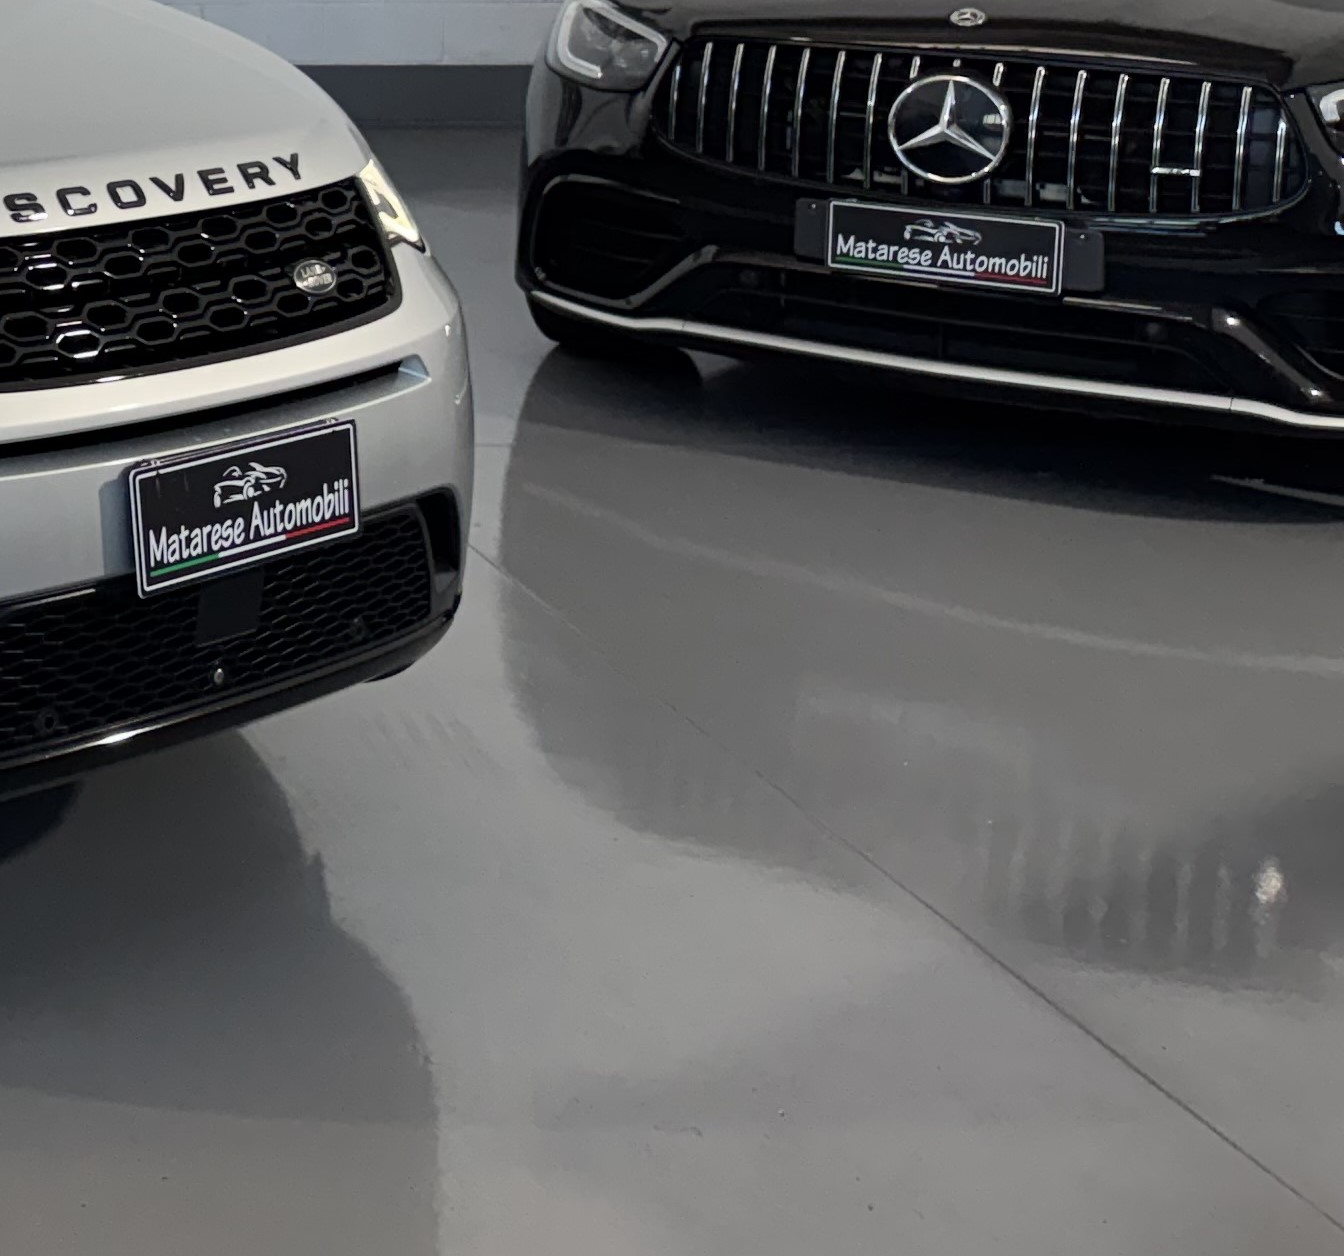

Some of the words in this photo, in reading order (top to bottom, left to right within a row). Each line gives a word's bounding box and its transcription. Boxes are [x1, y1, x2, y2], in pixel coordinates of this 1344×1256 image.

[835, 233, 933, 267] Matarese
[936, 244, 1049, 279] Automobili
[148, 516, 246, 568] Matarese
[249, 477, 350, 540] Automobili
